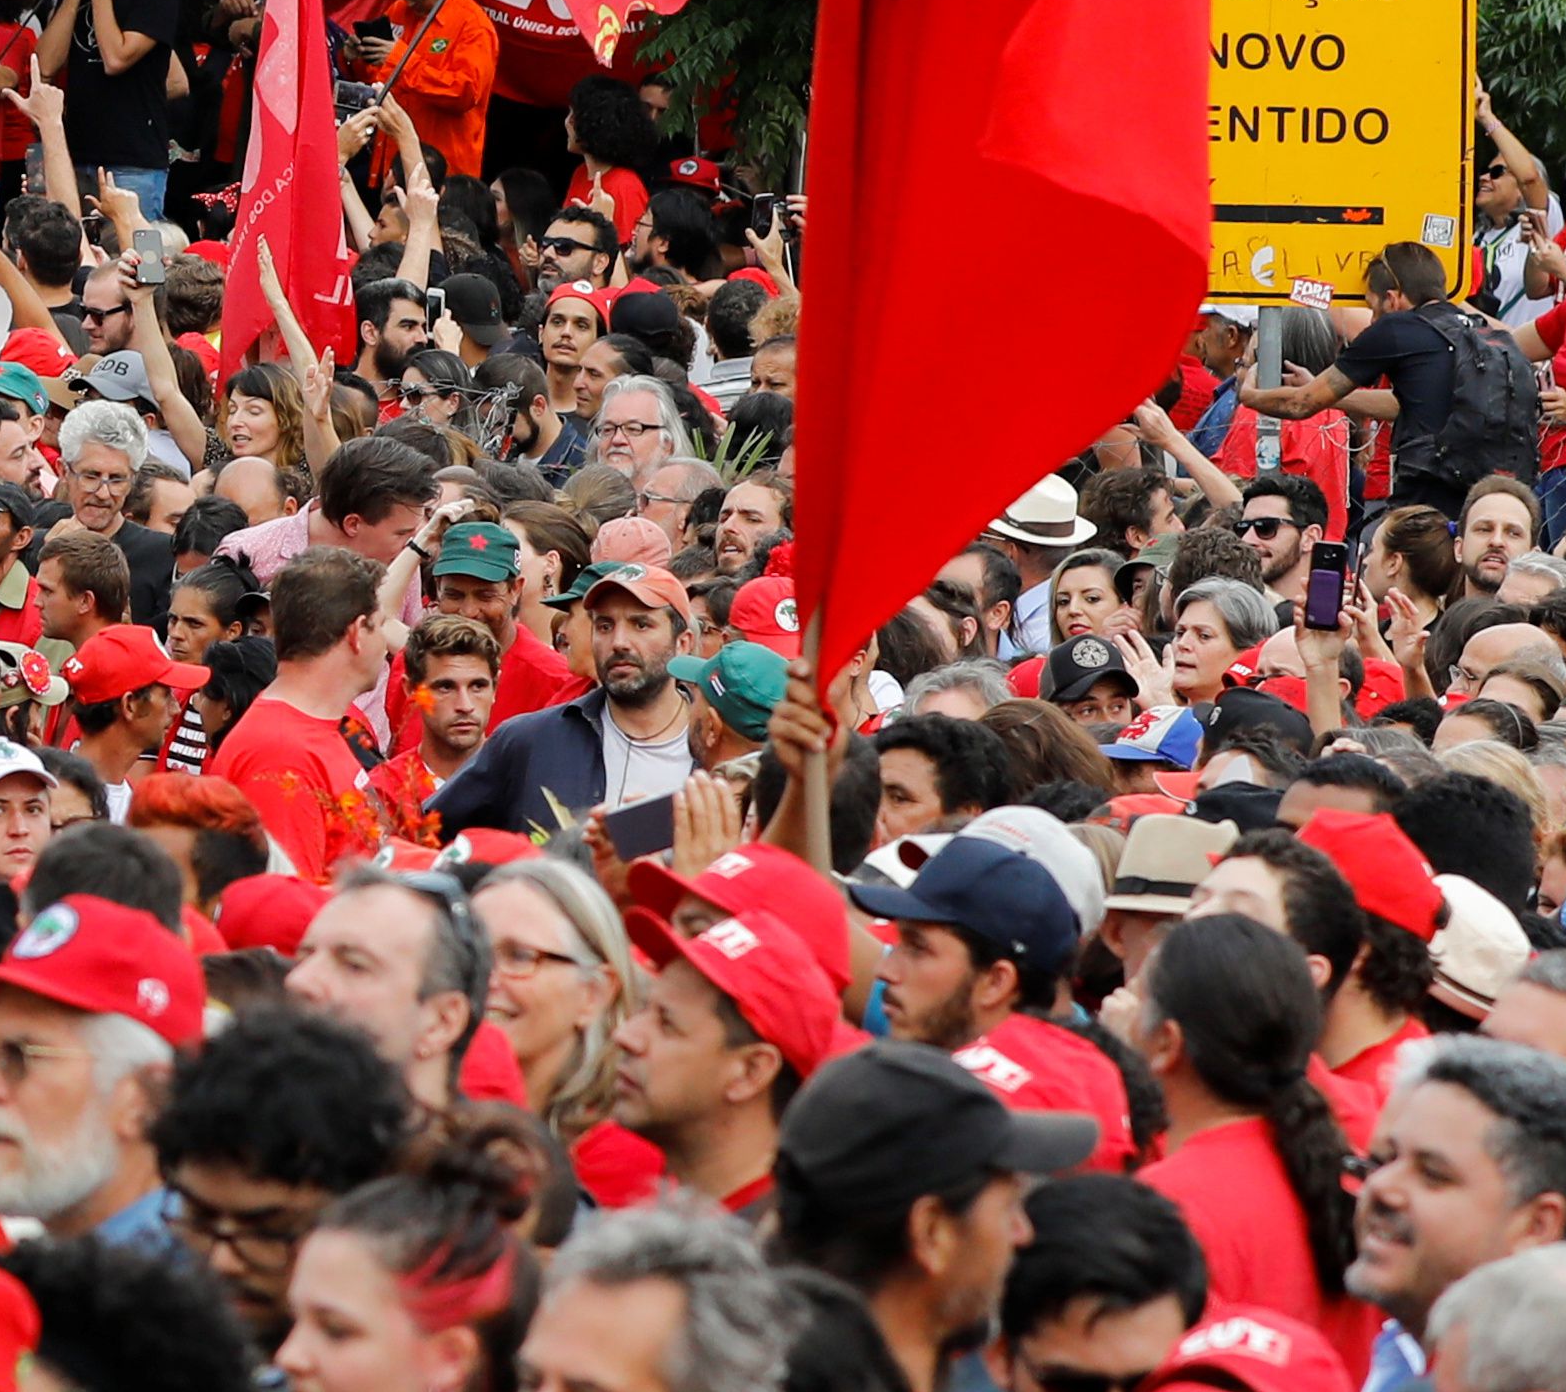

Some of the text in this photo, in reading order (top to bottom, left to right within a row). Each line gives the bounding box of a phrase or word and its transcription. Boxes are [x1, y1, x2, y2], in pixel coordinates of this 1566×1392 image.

[513, 15, 555, 35] ÚNICA
[1208, 32, 1346, 71] NOVO
[1208, 105, 1389, 145] ENTIDO
[1293, 278, 1334, 302] FORA
